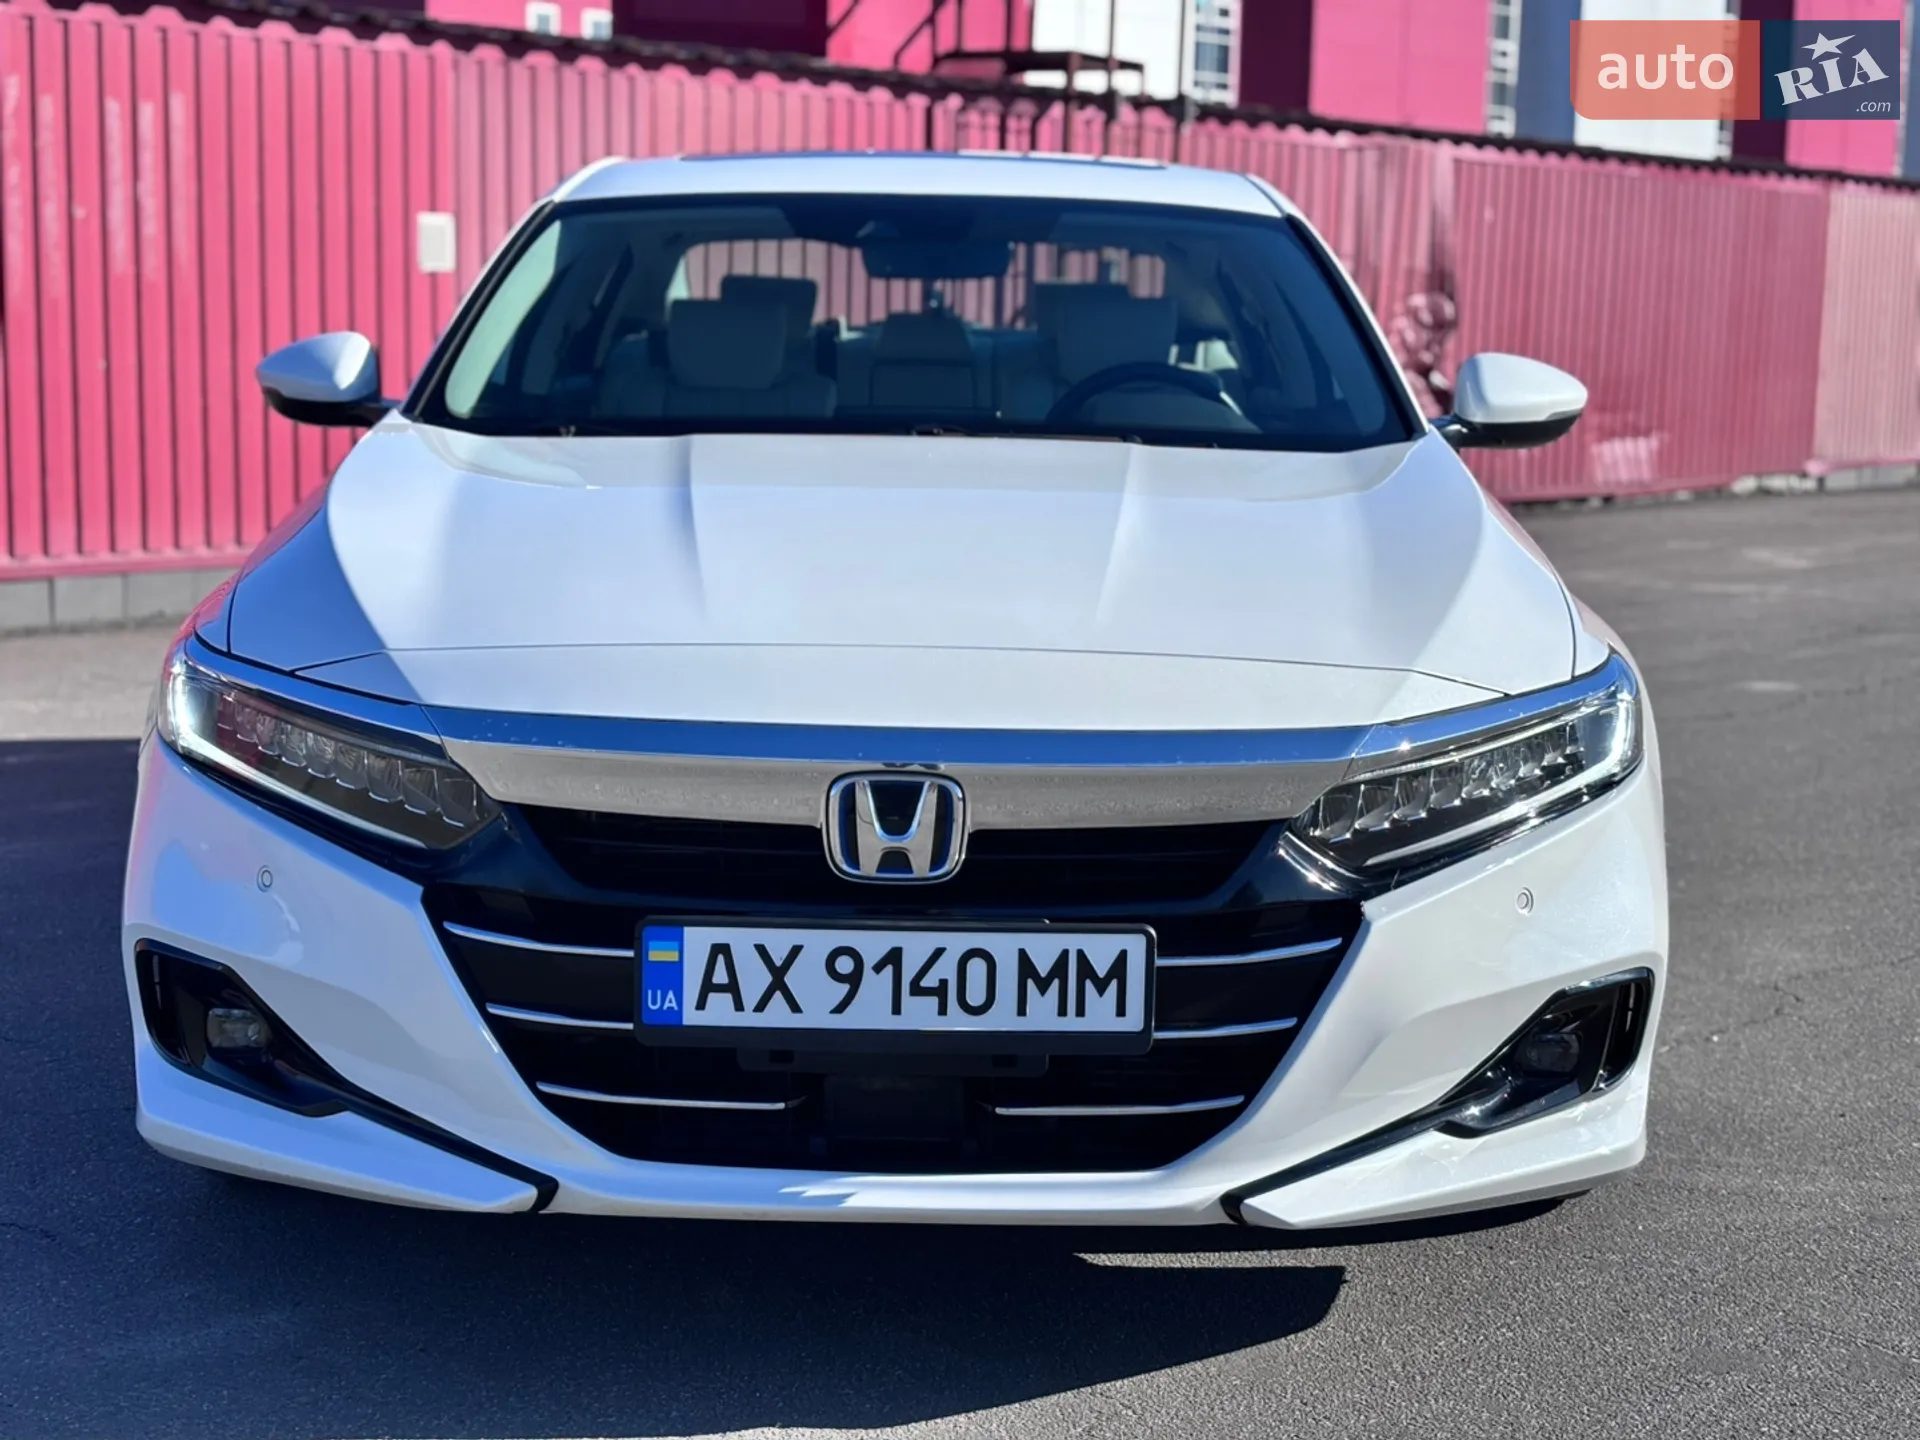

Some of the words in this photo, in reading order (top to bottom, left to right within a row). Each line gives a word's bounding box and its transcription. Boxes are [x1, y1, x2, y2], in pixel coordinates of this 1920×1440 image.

[647, 989, 679, 1011] UA
[694, 942, 805, 1014] AX
[824, 945, 998, 1017] 9140
[1016, 947, 1128, 1018] MM
